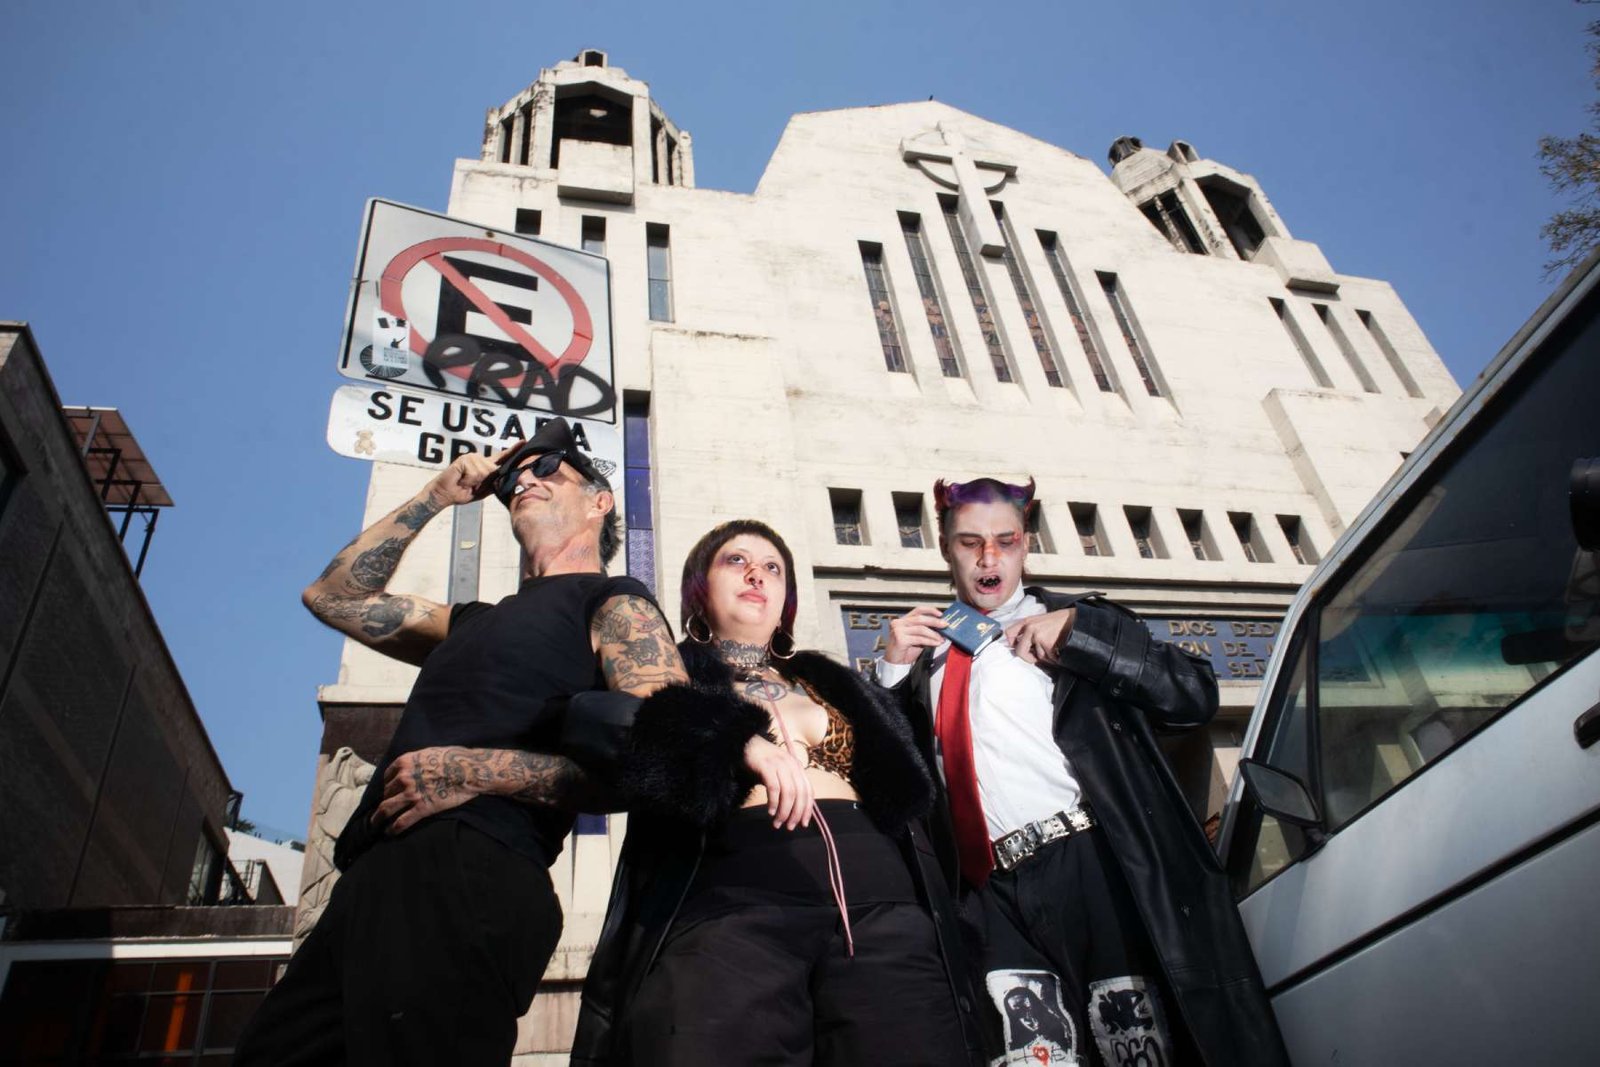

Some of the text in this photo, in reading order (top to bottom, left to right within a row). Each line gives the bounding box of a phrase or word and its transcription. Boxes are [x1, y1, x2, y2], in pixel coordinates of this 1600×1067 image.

[367, 391, 592, 452] SE USAA
[1168, 620, 1217, 637] DIOS
[1222, 641, 1256, 657] DE
[1227, 659, 1268, 678] SEÑ
